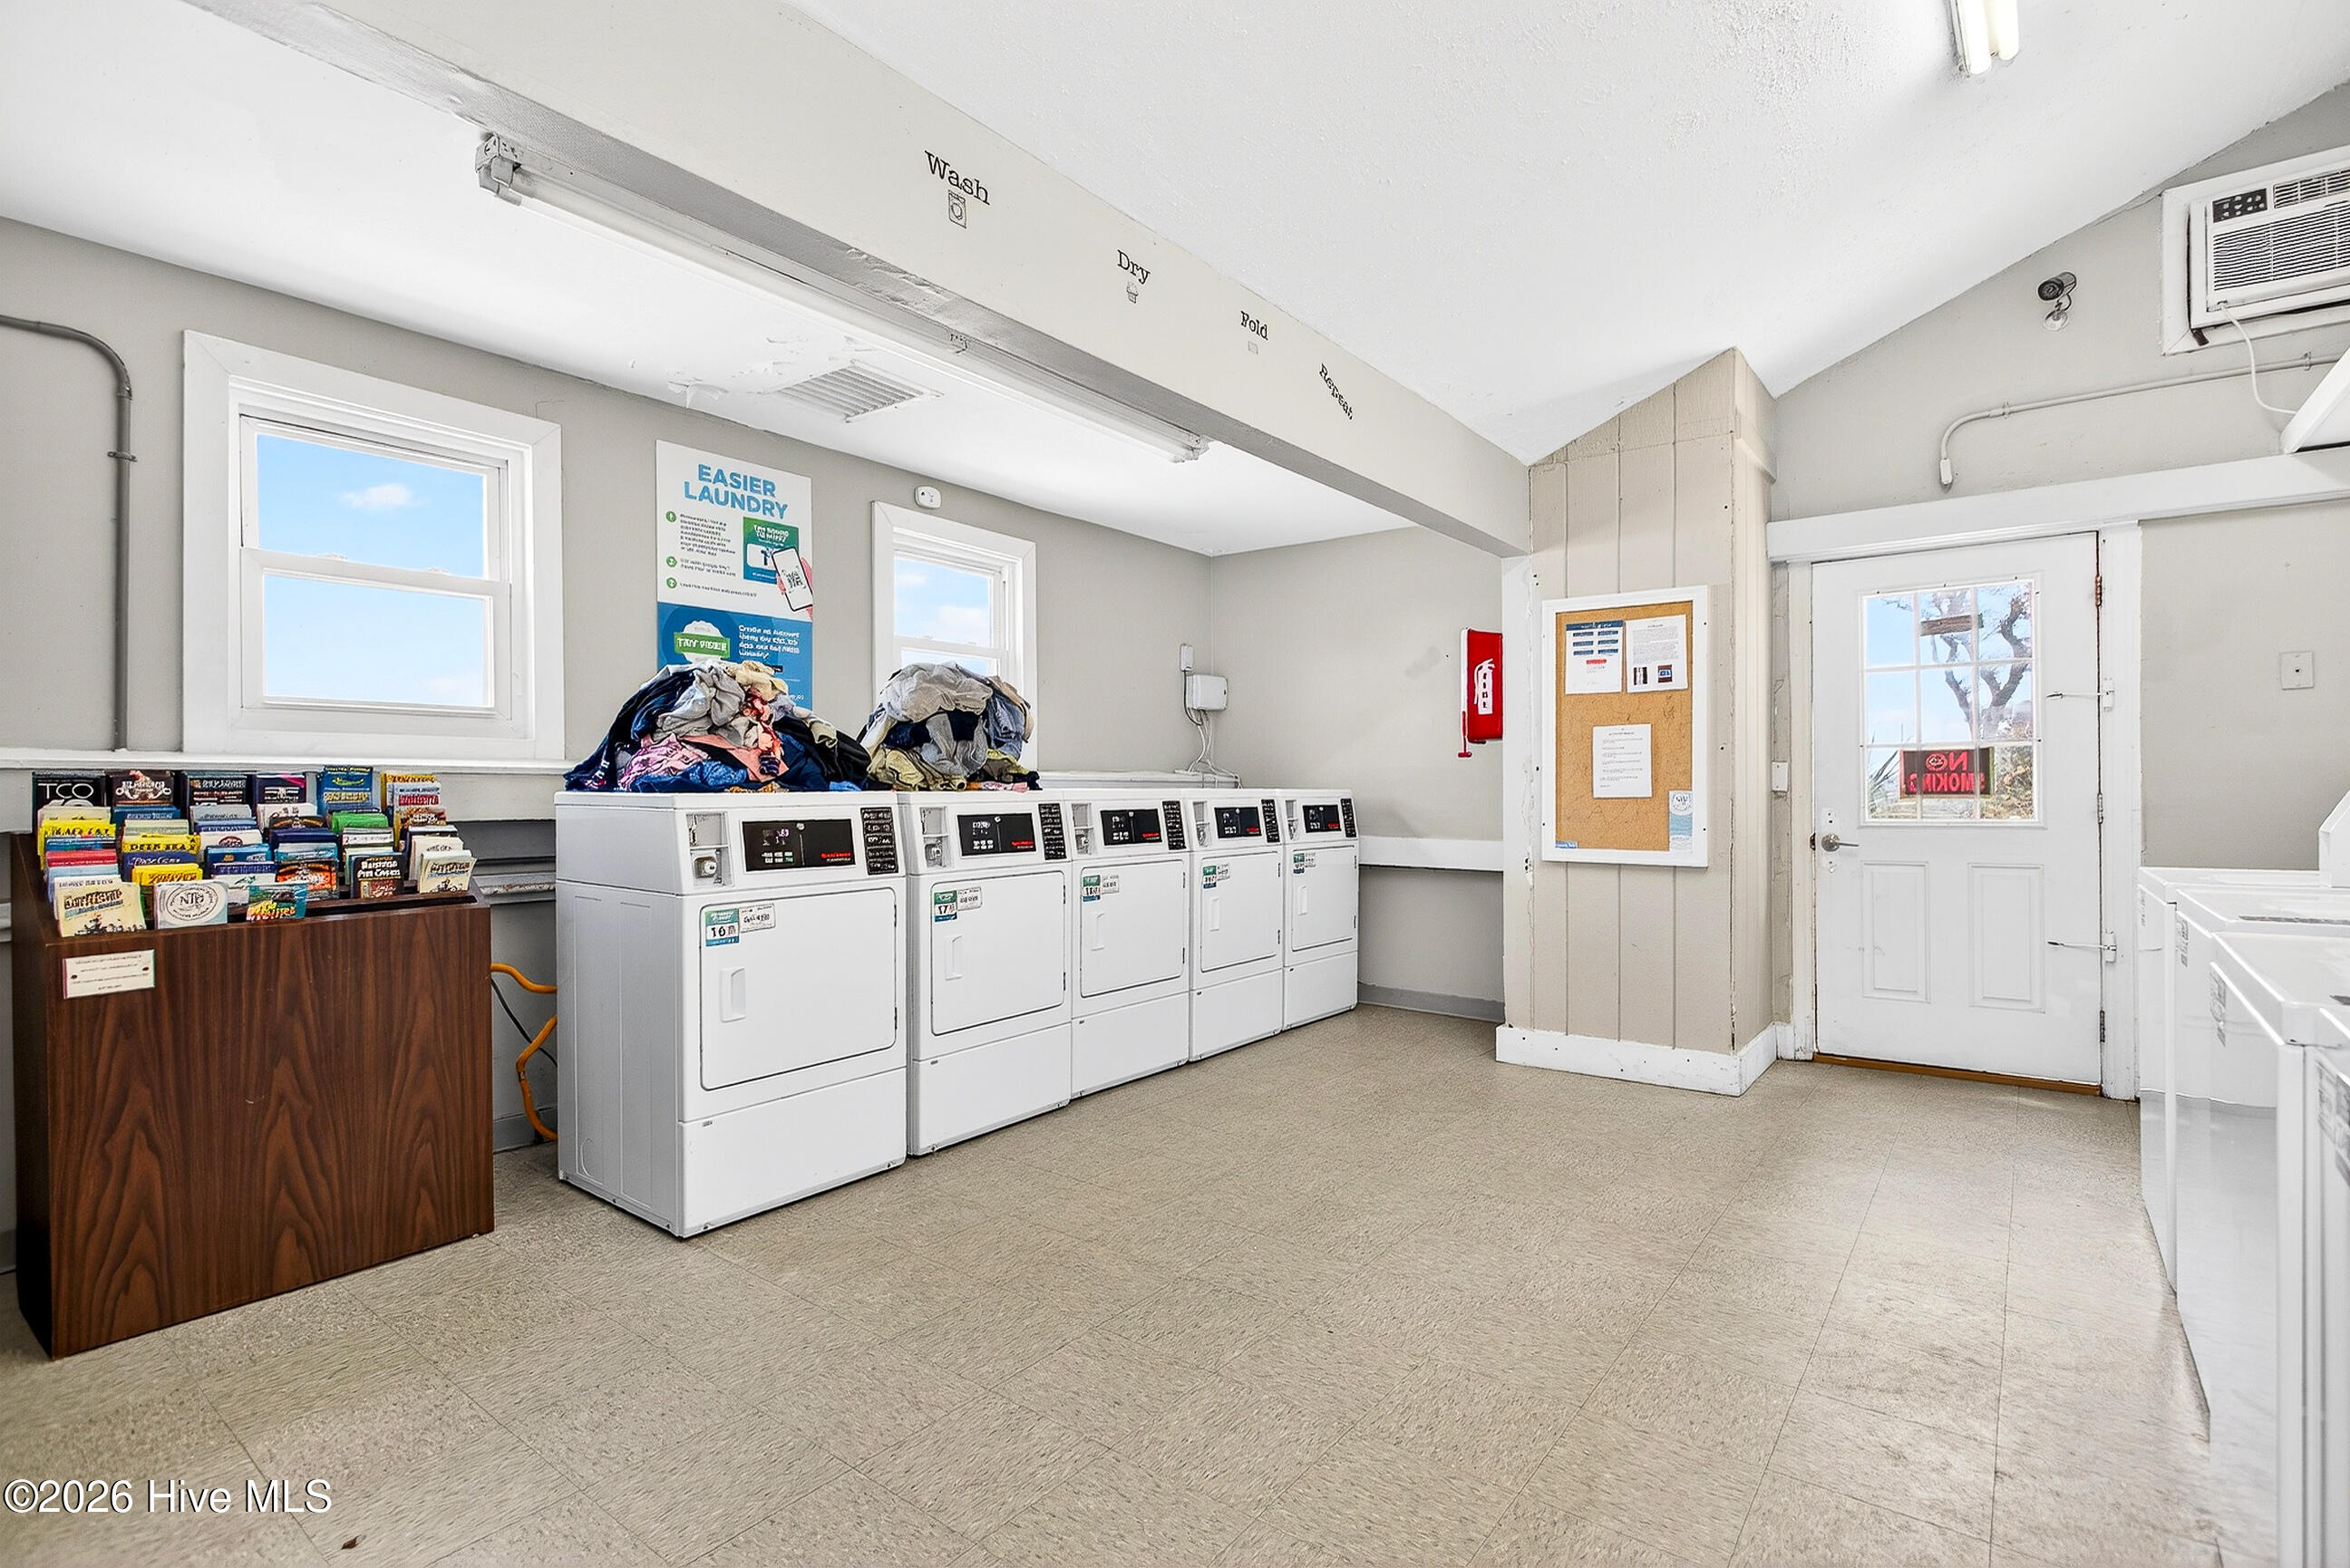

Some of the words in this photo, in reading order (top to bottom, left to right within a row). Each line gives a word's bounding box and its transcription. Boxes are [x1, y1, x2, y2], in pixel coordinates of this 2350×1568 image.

[924, 150, 991, 206] Wash
[1117, 248, 1151, 285] Dry
[1240, 310, 1268, 341] Fold
[698, 463, 776, 498] EASIER
[684, 480, 788, 520] LAUNDRY
[37, 782, 94, 799] TCO
[711, 925, 726, 938] 16
